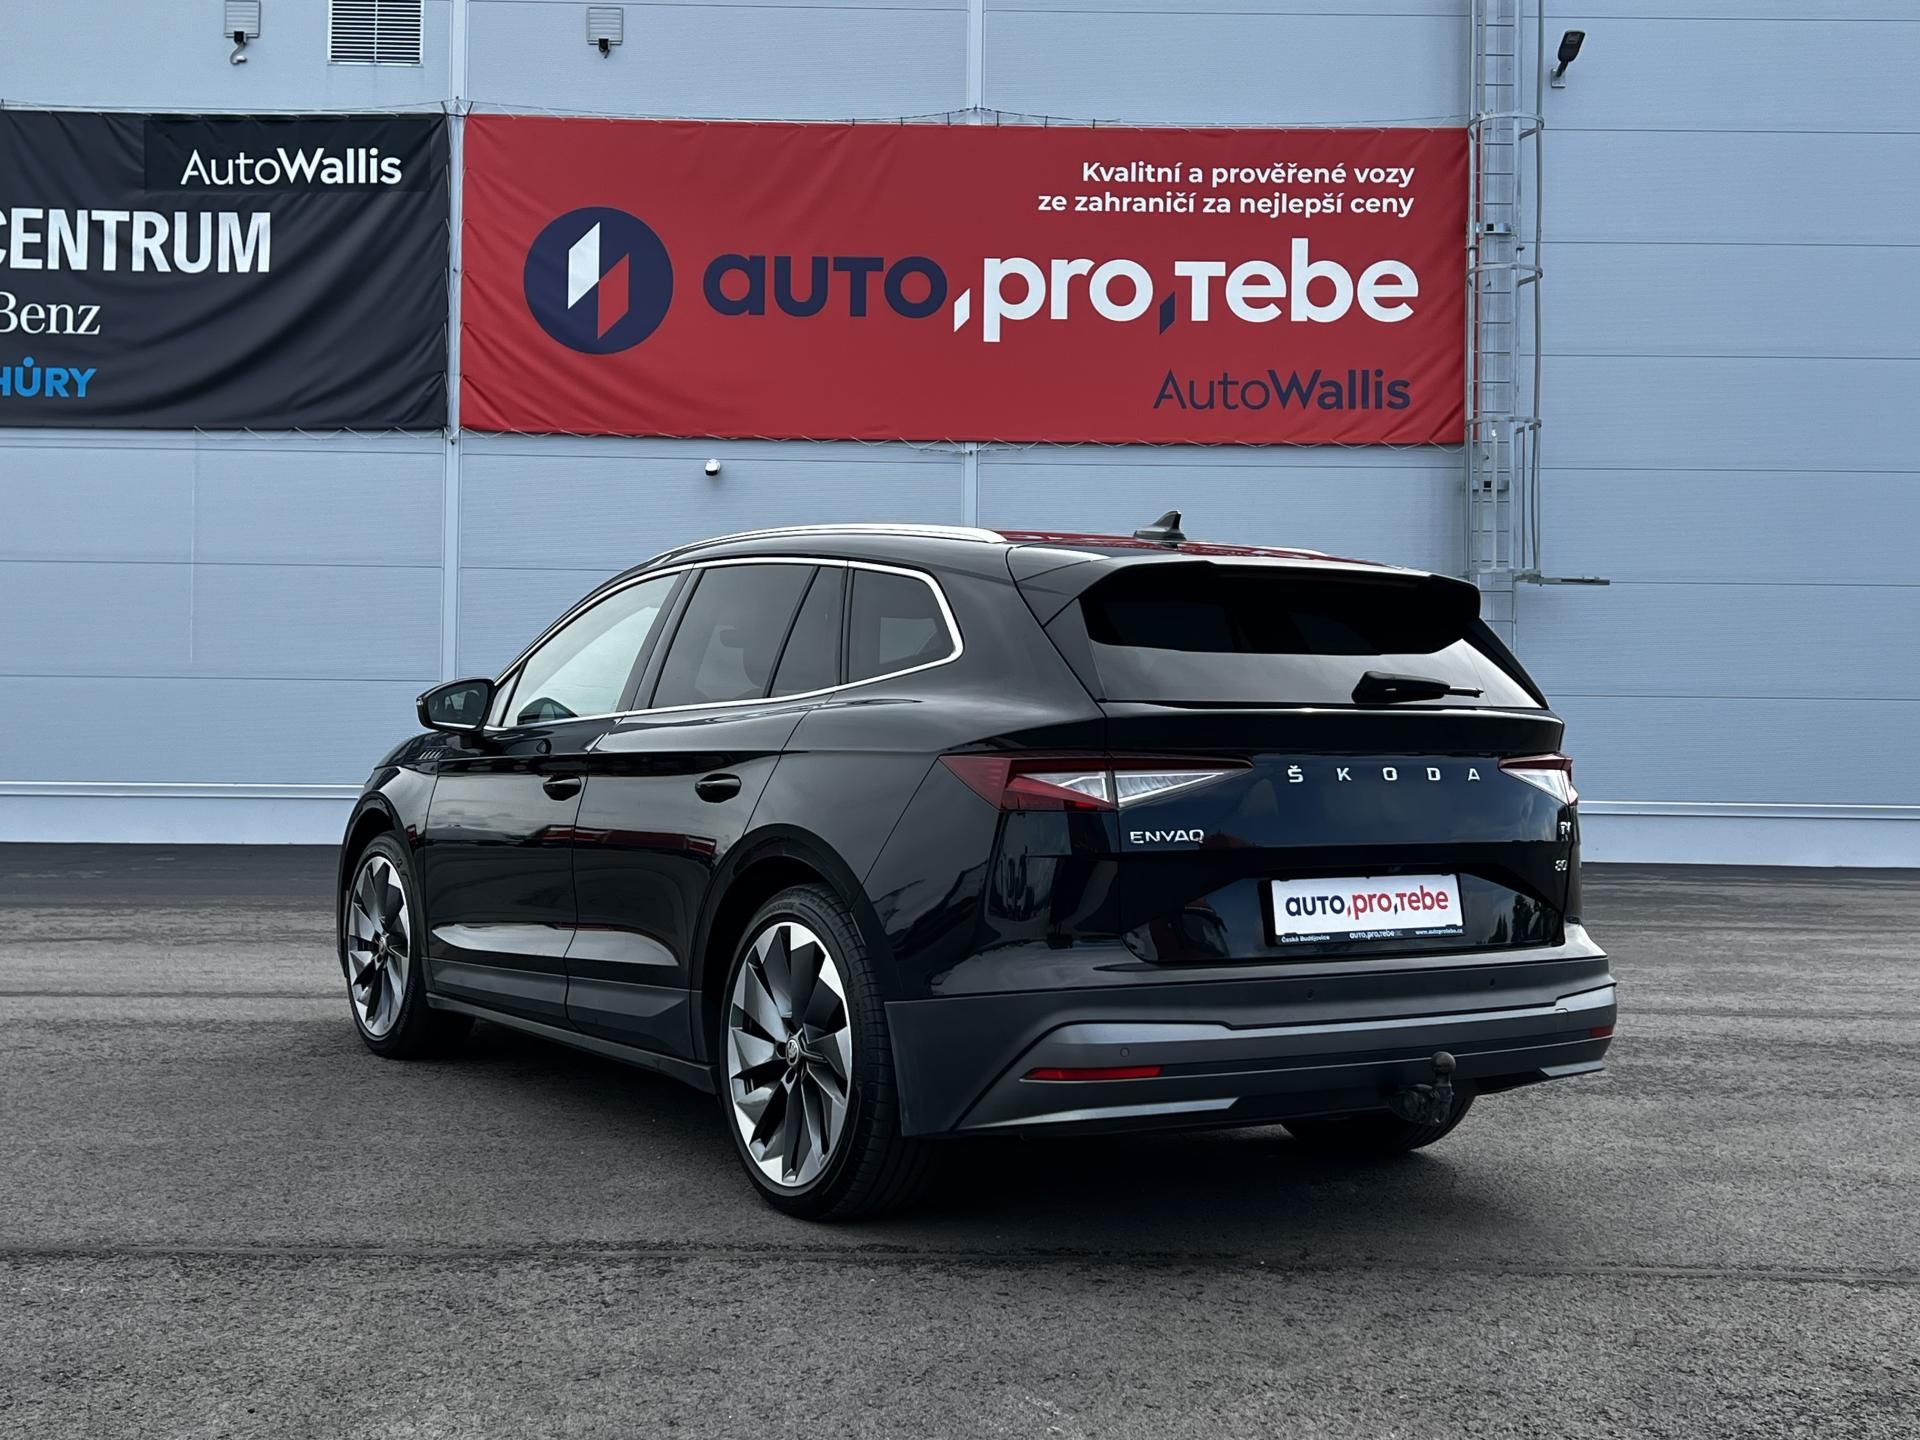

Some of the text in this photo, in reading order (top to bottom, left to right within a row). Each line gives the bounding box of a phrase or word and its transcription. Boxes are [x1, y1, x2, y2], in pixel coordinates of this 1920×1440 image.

[181, 148, 402, 186] AutoWallis
[1082, 161, 1416, 189] Kvalitní a prověřené vozy
[1037, 190, 1415, 219] ze zahraničí za nejlepší ceny
[0, 206, 272, 274] ENTRUM
[1153, 368, 1411, 411] AutoWallis
[1287, 764, 1481, 783] ŠKODA
